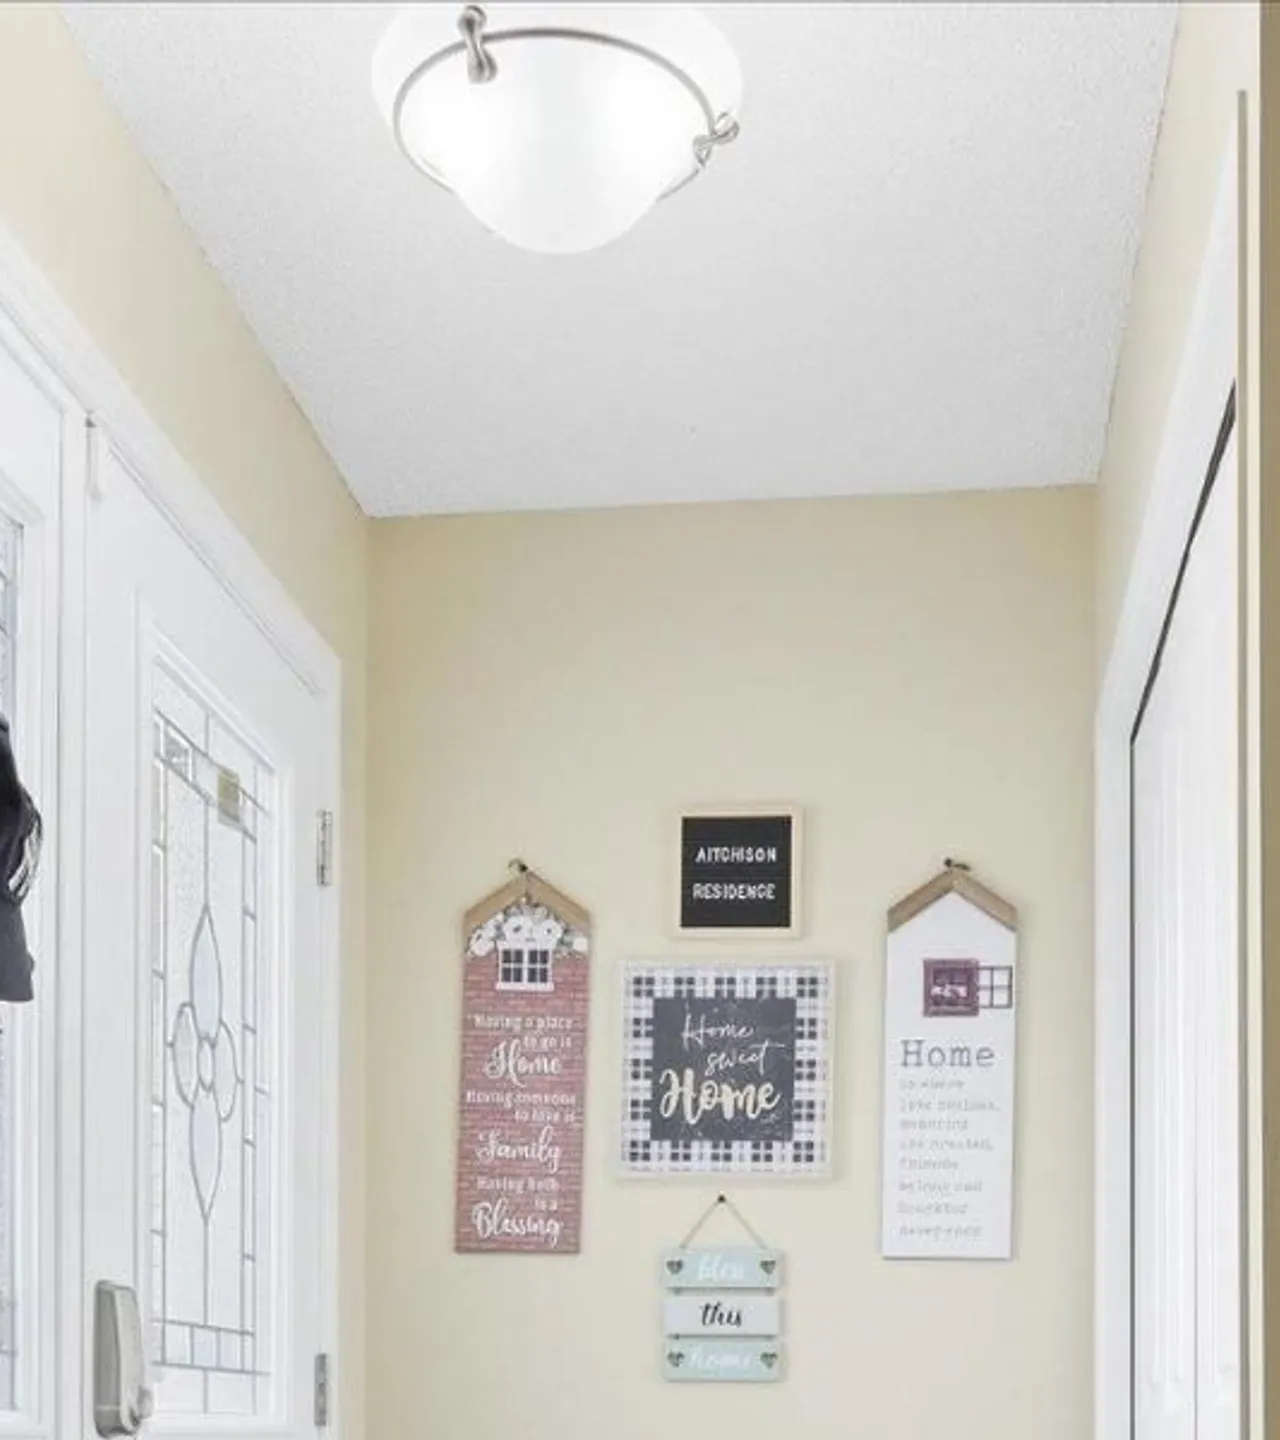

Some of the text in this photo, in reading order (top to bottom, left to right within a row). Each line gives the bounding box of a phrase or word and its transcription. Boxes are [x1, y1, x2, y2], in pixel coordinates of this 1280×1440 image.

[695, 846, 777, 863] AITCHISON
[692, 882, 776, 900] RESIDENCE
[681, 1013, 754, 1052] Home
[482, 1038, 562, 1089] Home
[705, 1038, 786, 1076] sweet
[900, 1038, 995, 1068] Home
[659, 1067, 781, 1125] Home
[474, 1124, 562, 1175] Family
[471, 1197, 564, 1248] Blessing
[699, 1300, 743, 1327] this
